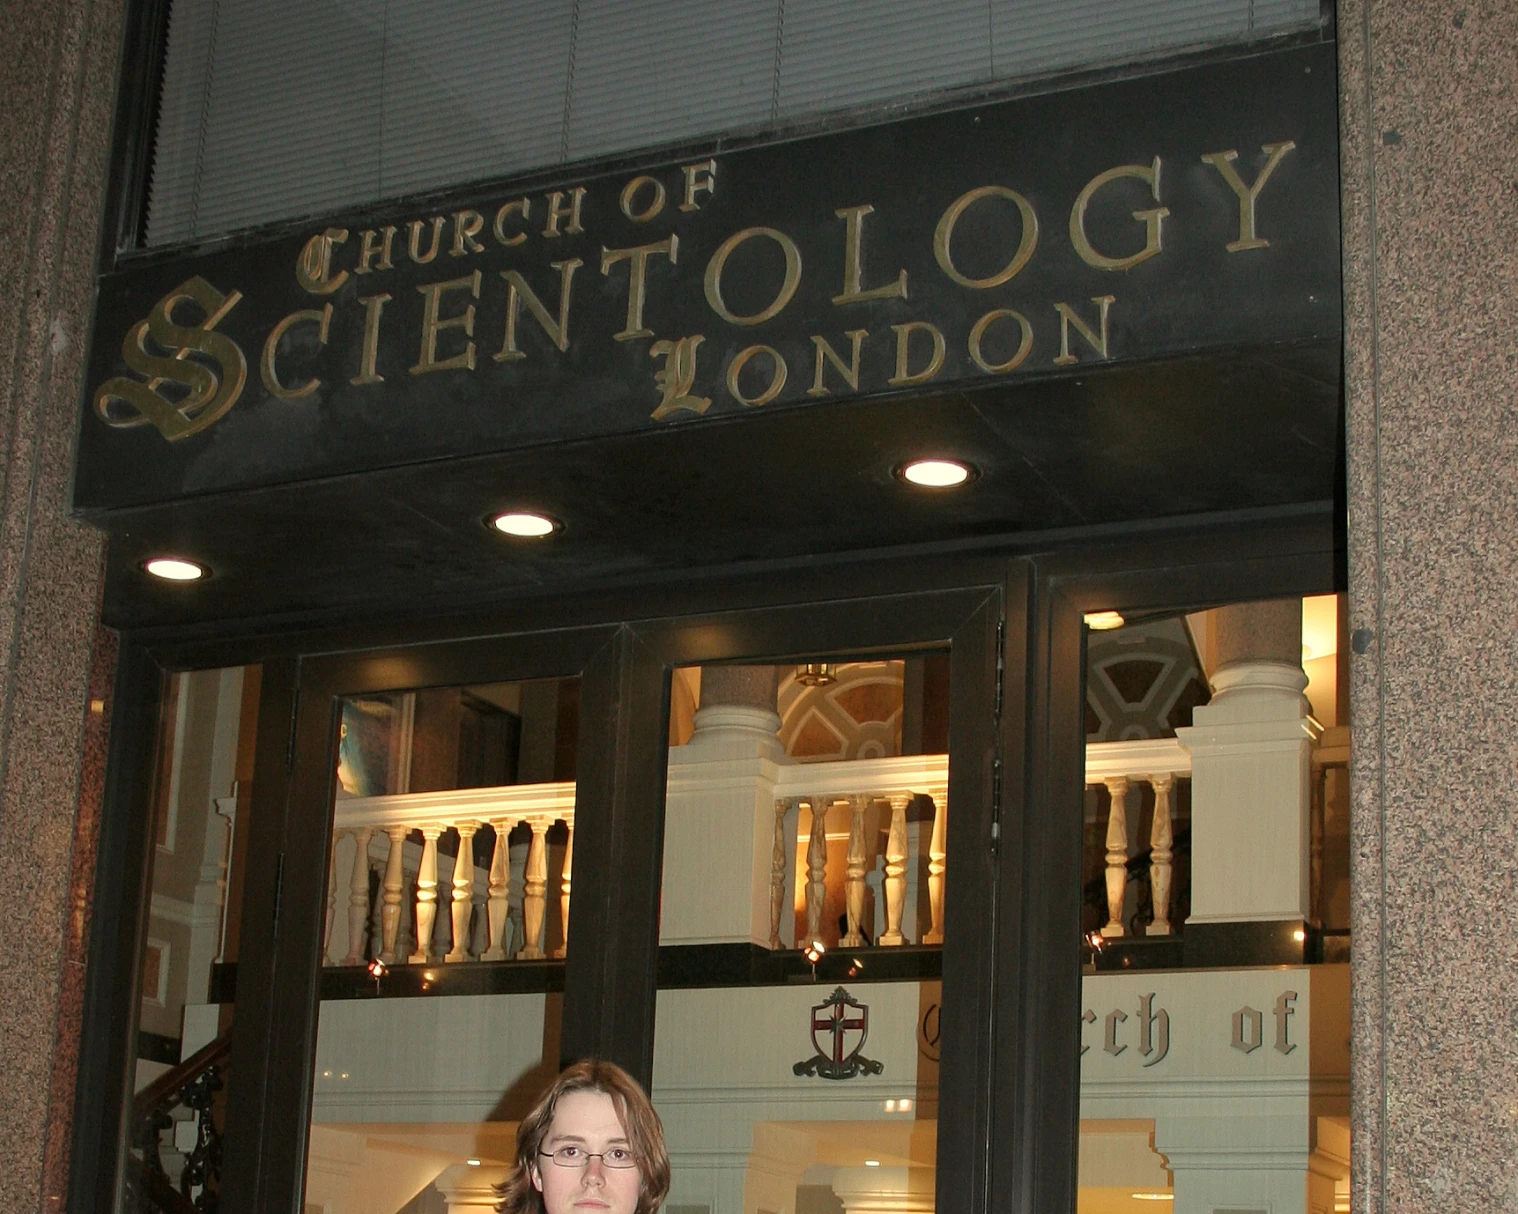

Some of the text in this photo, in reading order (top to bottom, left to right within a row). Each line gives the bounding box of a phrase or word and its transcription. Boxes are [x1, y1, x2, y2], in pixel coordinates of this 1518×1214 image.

[93, 139, 1296, 442] SCIENTOLOGY
[296, 157, 717, 294] CHURCH OF
[648, 294, 1116, 420] LONDON
[1230, 990, 1300, 1057] of
